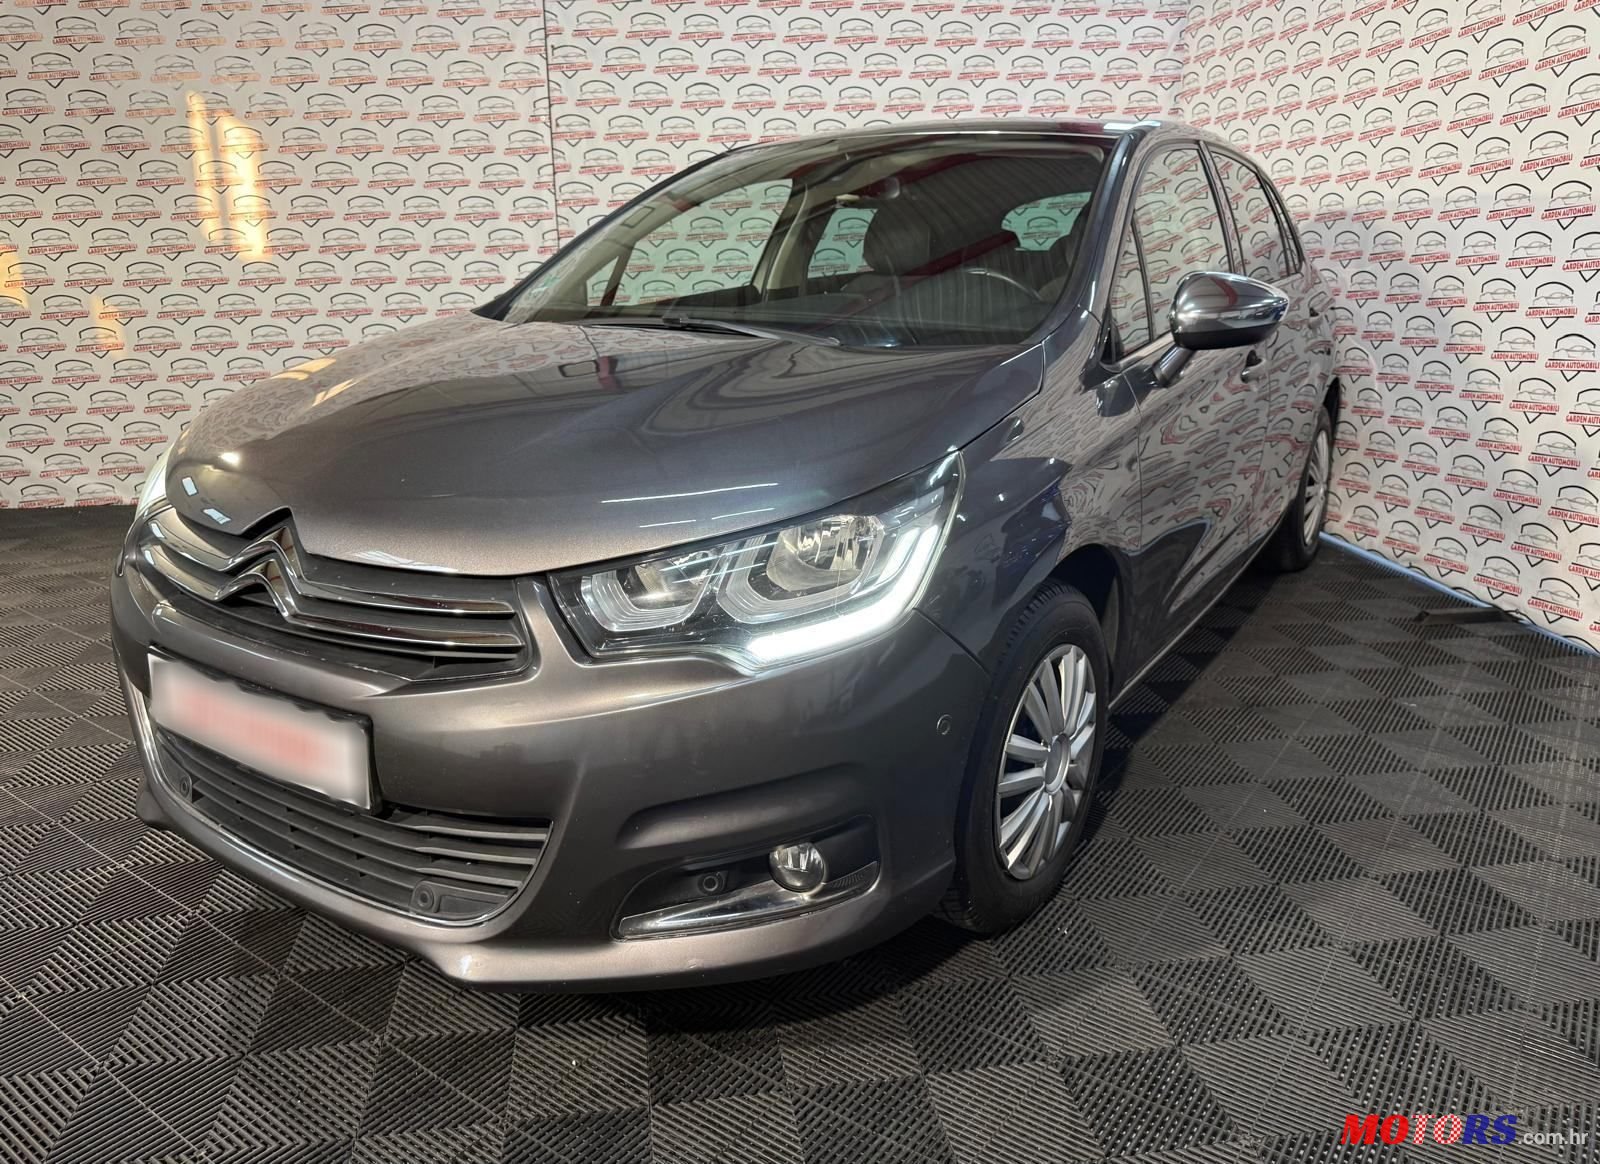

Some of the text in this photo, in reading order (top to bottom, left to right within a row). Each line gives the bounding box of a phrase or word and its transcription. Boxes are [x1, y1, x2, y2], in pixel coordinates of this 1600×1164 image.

[1533, 0, 1566, 18] AUTOMOBILI
[1476, 13, 1505, 30] AUTOMOBILI
[1556, 46, 1590, 63] AUTOMOBILI
[1497, 58, 1528, 74] AUTOMOBILI
[1465, 112, 1494, 126] AUTOMOBILI
[1519, 105, 1550, 120] AUTOMOBILI
[1540, 153, 1572, 167] AUTOMOBILI
[1505, 206, 1534, 217] AUTOMOBILI
[1562, 204, 1595, 216] AUTOMOBILI
[1525, 255, 1555, 265] AUTOMOBILI
[1545, 307, 1577, 315] AUTOMOBILI
[1528, 403, 1559, 412] AUTOMOBILI
[1548, 456, 1580, 467] AUTOMOBILI
[1512, 493, 1541, 505] AUTOMOBILI
[1530, 547, 1561, 560] AUTOMOBILI
[1492, 580, 1522, 594] AUTOMOBILI
[1549, 603, 1582, 619] AUTOMOBILI
